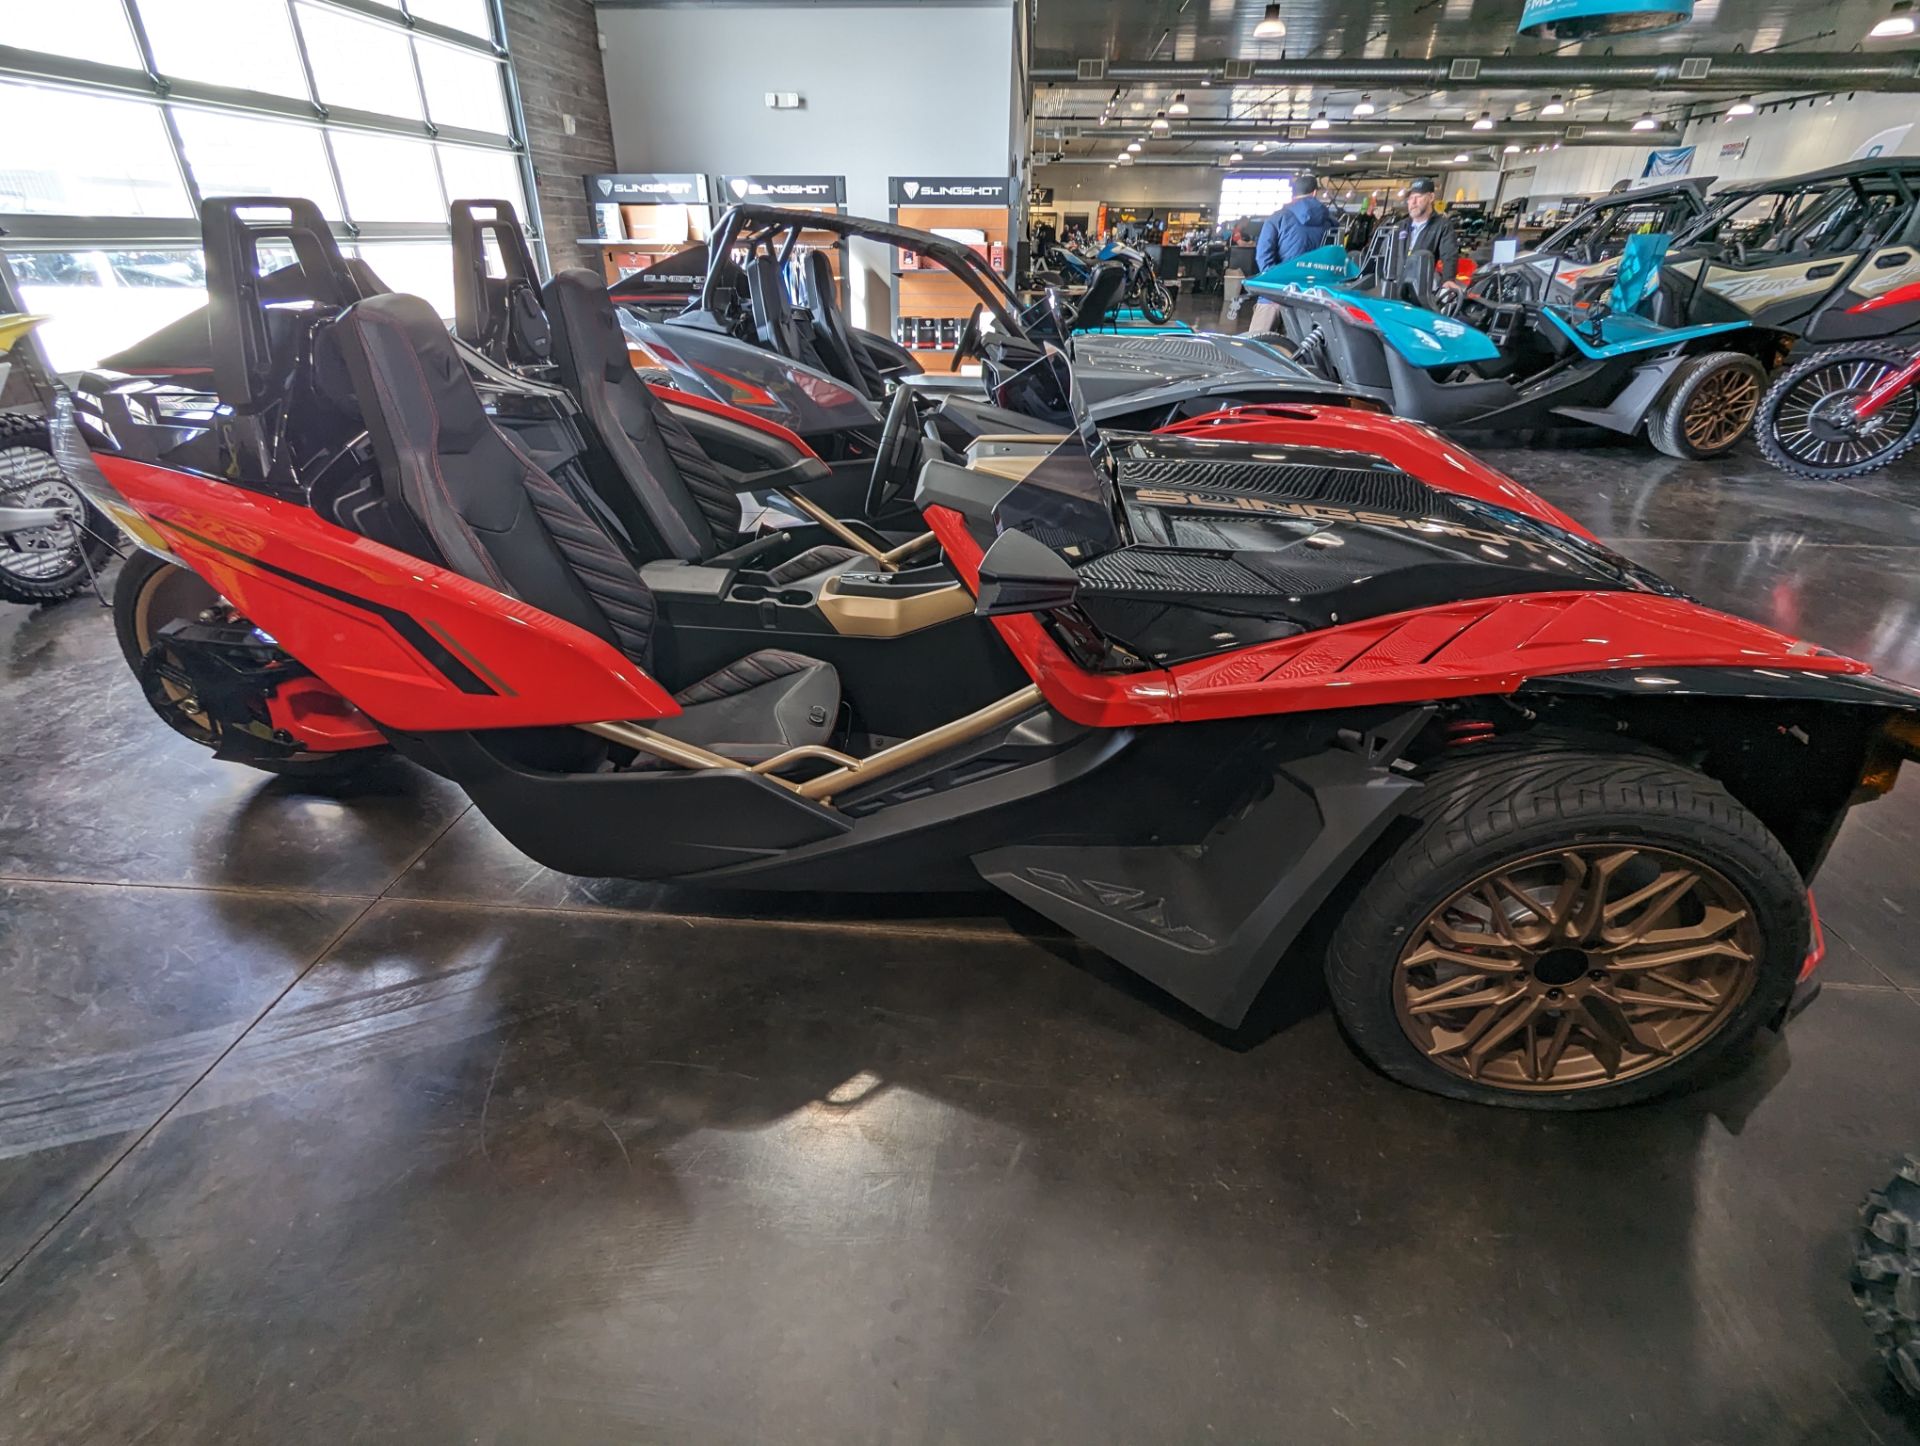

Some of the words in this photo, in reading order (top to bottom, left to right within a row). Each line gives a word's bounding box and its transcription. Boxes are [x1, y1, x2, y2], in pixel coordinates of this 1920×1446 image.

[614, 184, 692, 194] SLINGSHOT
[748, 184, 829, 195] SLINGSHOT
[920, 186, 1003, 195] SLINGSHOT
[643, 274, 706, 284] SLINGSHO
[1135, 488, 1552, 554] SLINGSHOT
